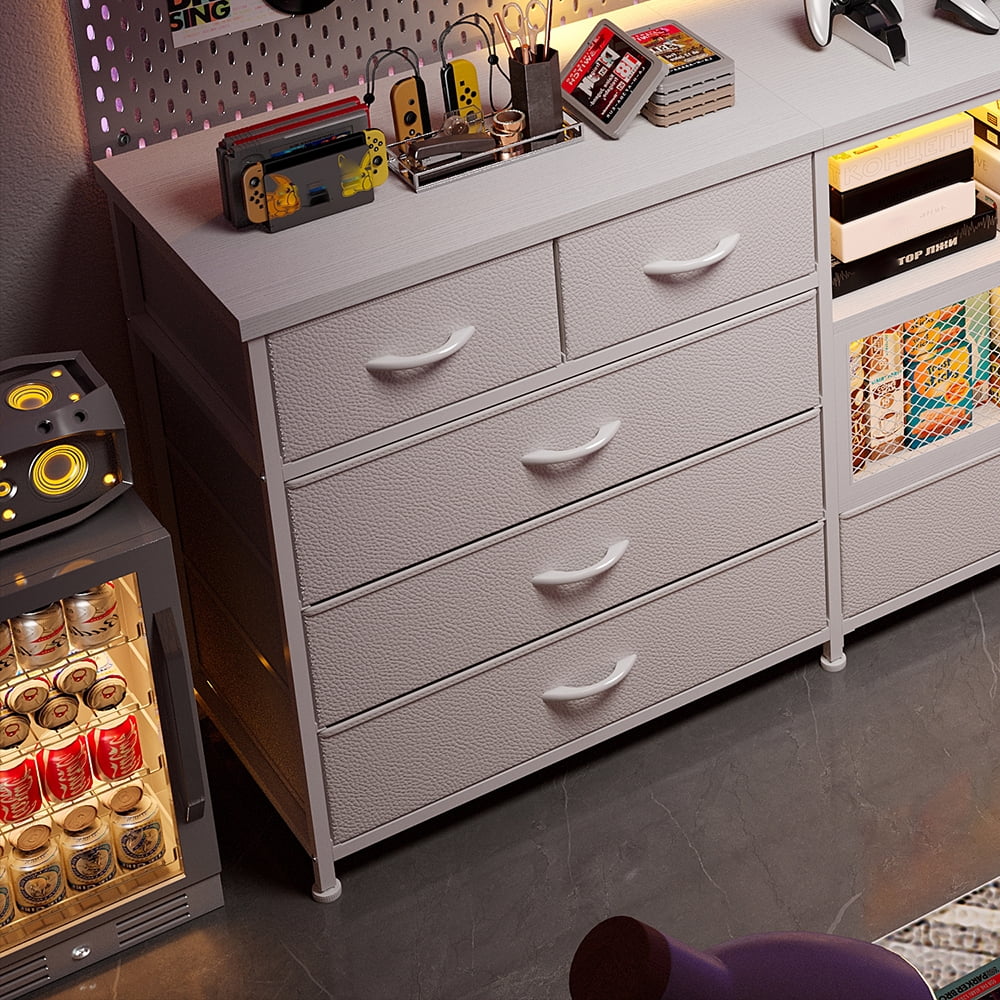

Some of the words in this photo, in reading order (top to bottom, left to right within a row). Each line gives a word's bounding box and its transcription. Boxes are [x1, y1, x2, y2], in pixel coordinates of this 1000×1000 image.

[168, 0, 231, 32] SING
[925, 236, 958, 257] ЛЖИ
[957, 971, 989, 994] PARKER
